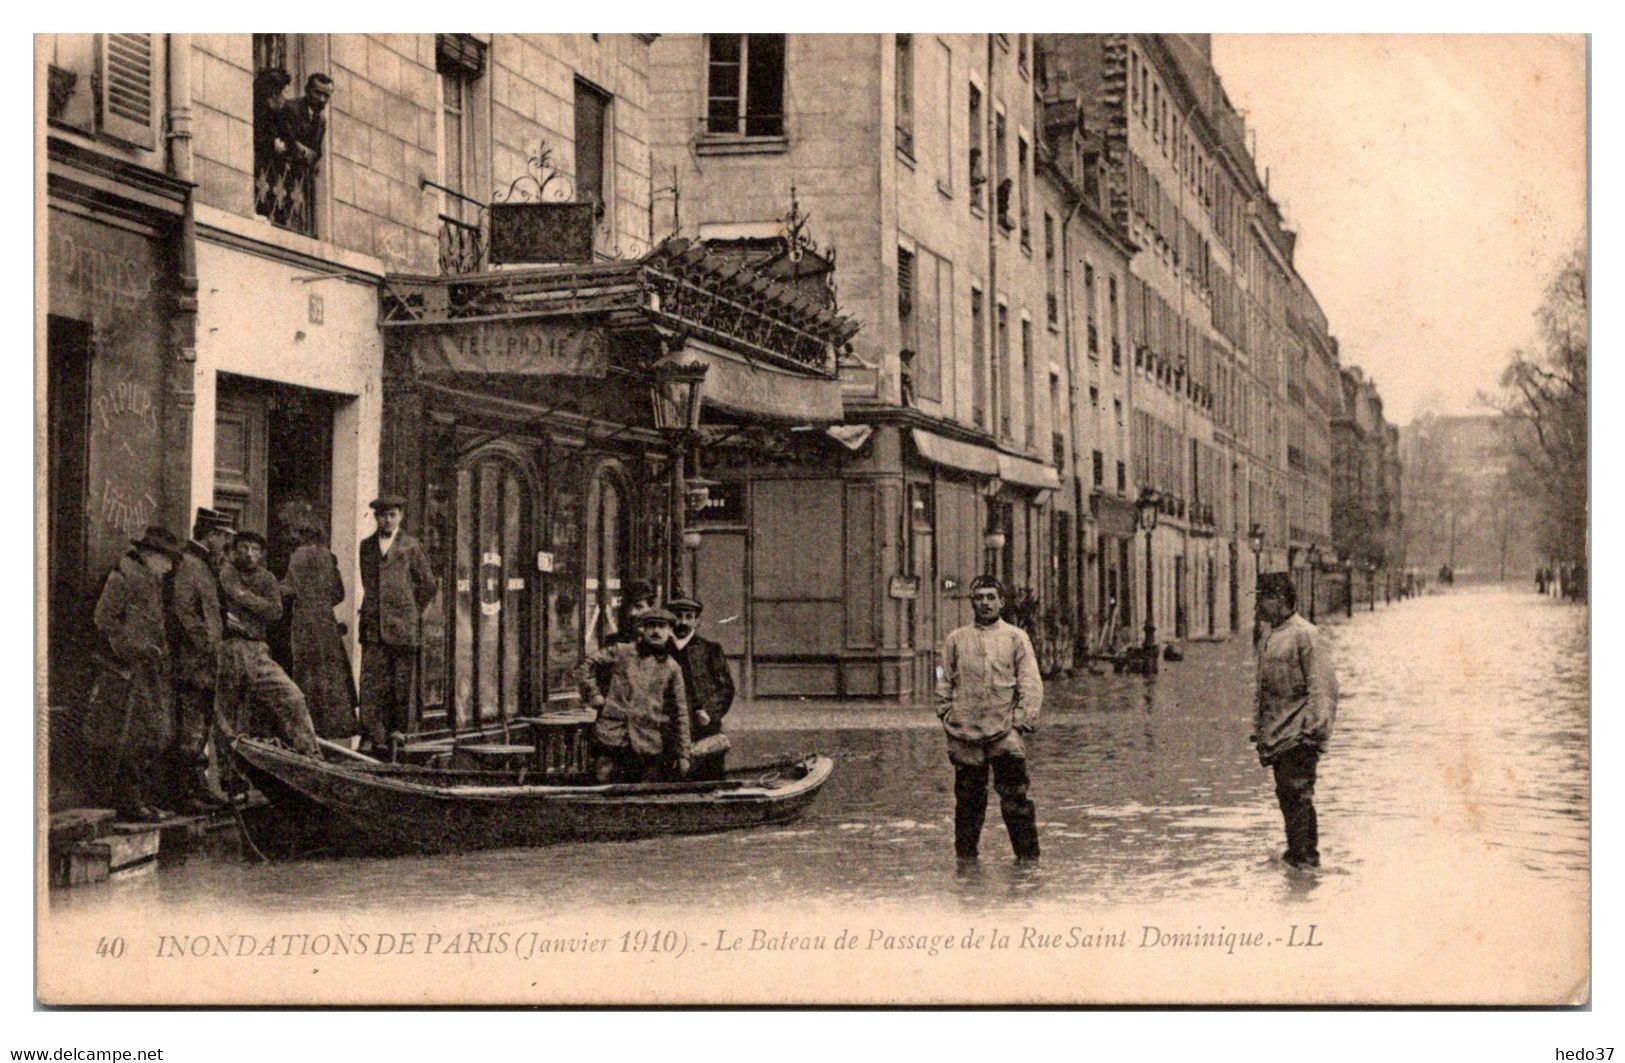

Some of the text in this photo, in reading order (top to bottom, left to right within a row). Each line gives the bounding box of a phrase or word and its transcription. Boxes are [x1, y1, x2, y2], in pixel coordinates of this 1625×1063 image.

[96, 936, 128, 959] 40
[156, 933, 371, 957] INONDATIONS
[373, 932, 417, 956] DE
[424, 930, 510, 955] PARIS
[514, 931, 611, 961] (Janvier
[715, 929, 743, 952] Le
[747, 928, 825, 951] Bateau
[833, 928, 859, 951] de
[865, 928, 955, 957] Passage
[960, 927, 985, 950] de
[989, 928, 1009, 950] la
[1018, 926, 1063, 949] Rue
[1065, 926, 1127, 949] Saint
